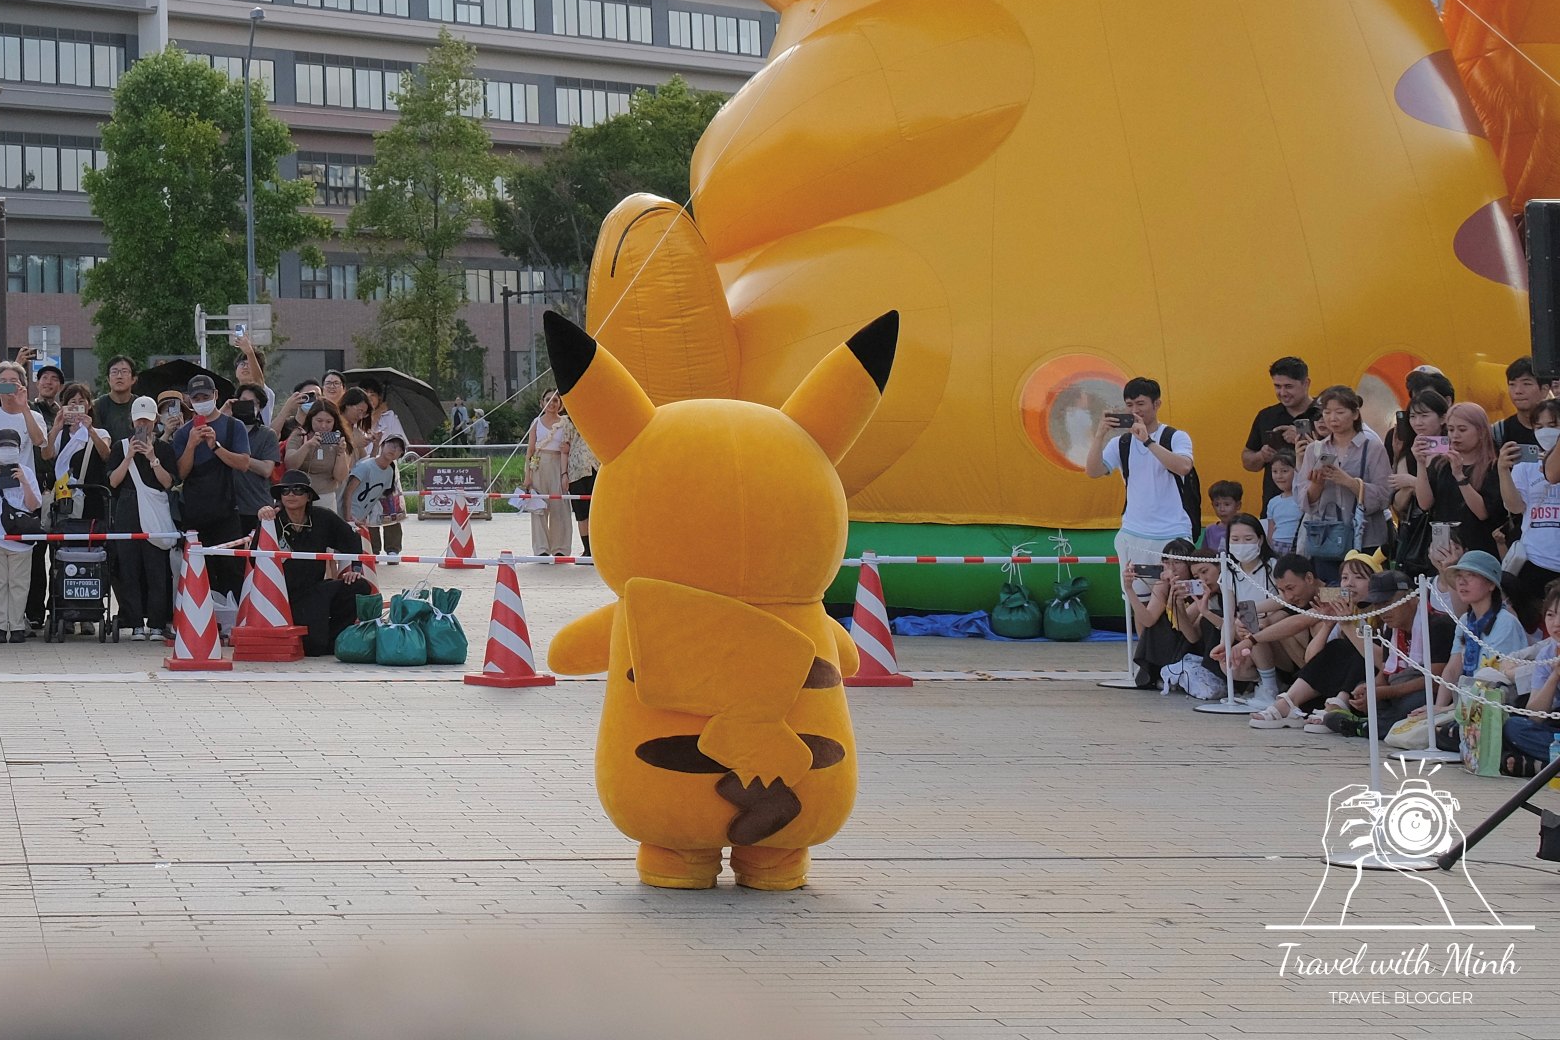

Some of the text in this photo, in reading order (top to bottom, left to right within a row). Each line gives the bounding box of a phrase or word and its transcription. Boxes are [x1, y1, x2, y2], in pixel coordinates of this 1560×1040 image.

[433, 475, 475, 485] 乗入禁止
[75, 587, 89, 597] KOA
